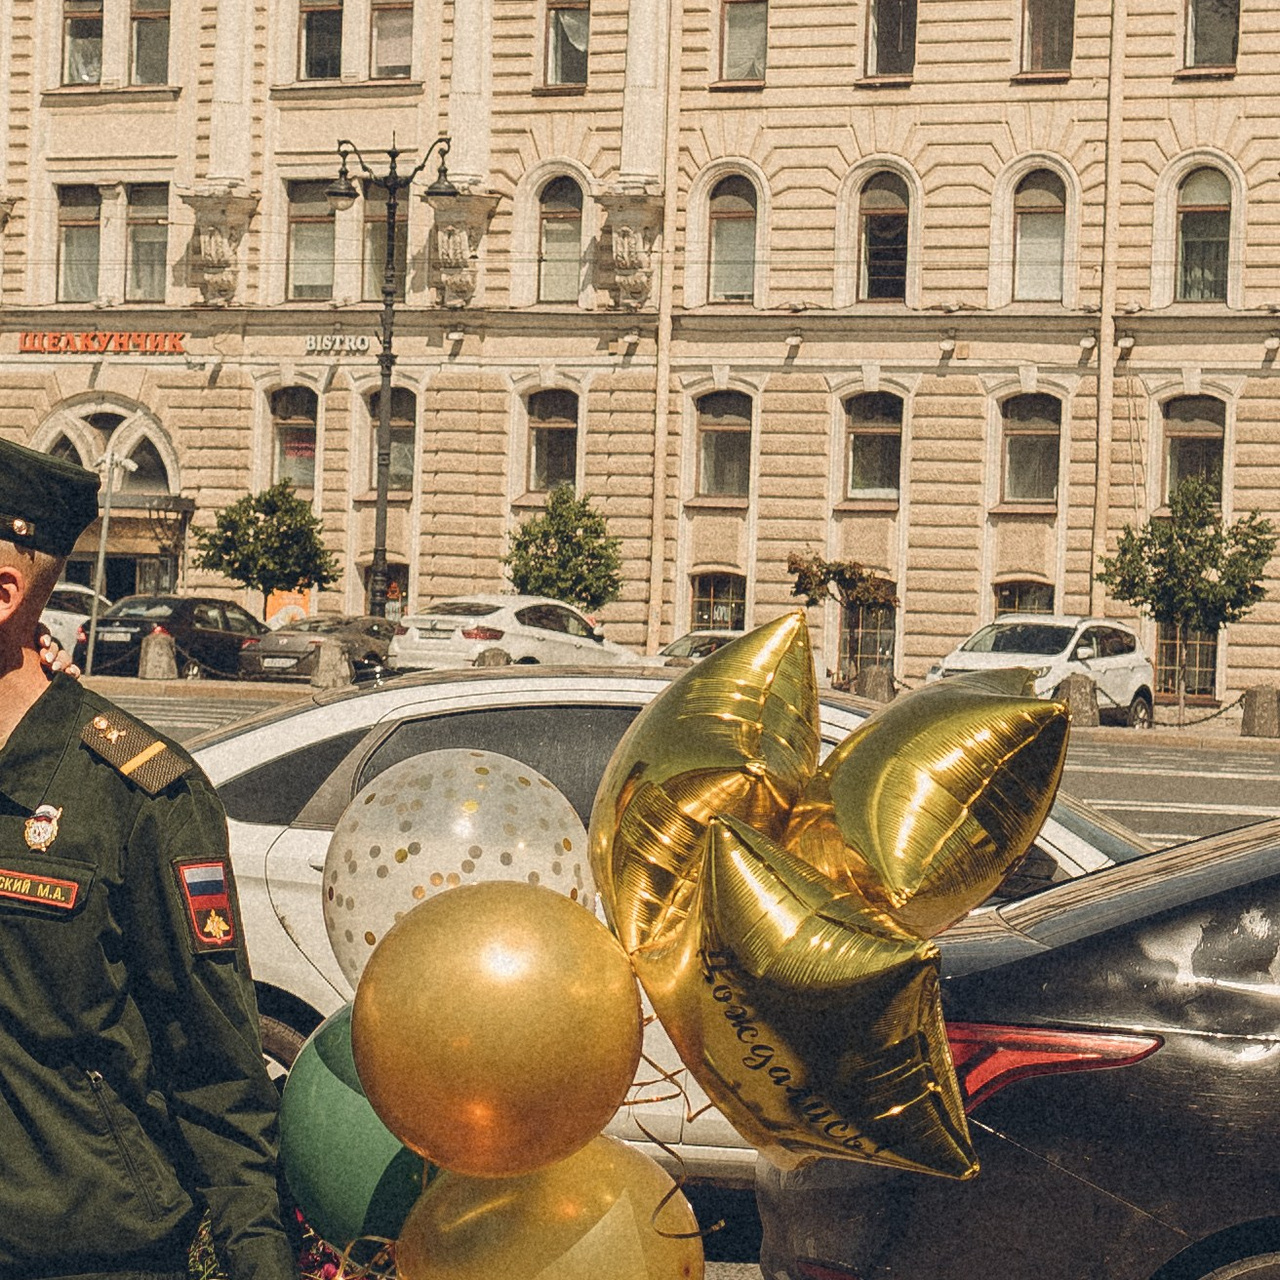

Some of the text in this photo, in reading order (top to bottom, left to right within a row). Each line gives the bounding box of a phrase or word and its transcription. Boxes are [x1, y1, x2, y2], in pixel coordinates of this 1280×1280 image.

[19, 331, 187, 353] ЩЕЛКУНЧИК
[306, 334, 370, 351] BISTRO
[36, 883, 66, 901] М.А.
